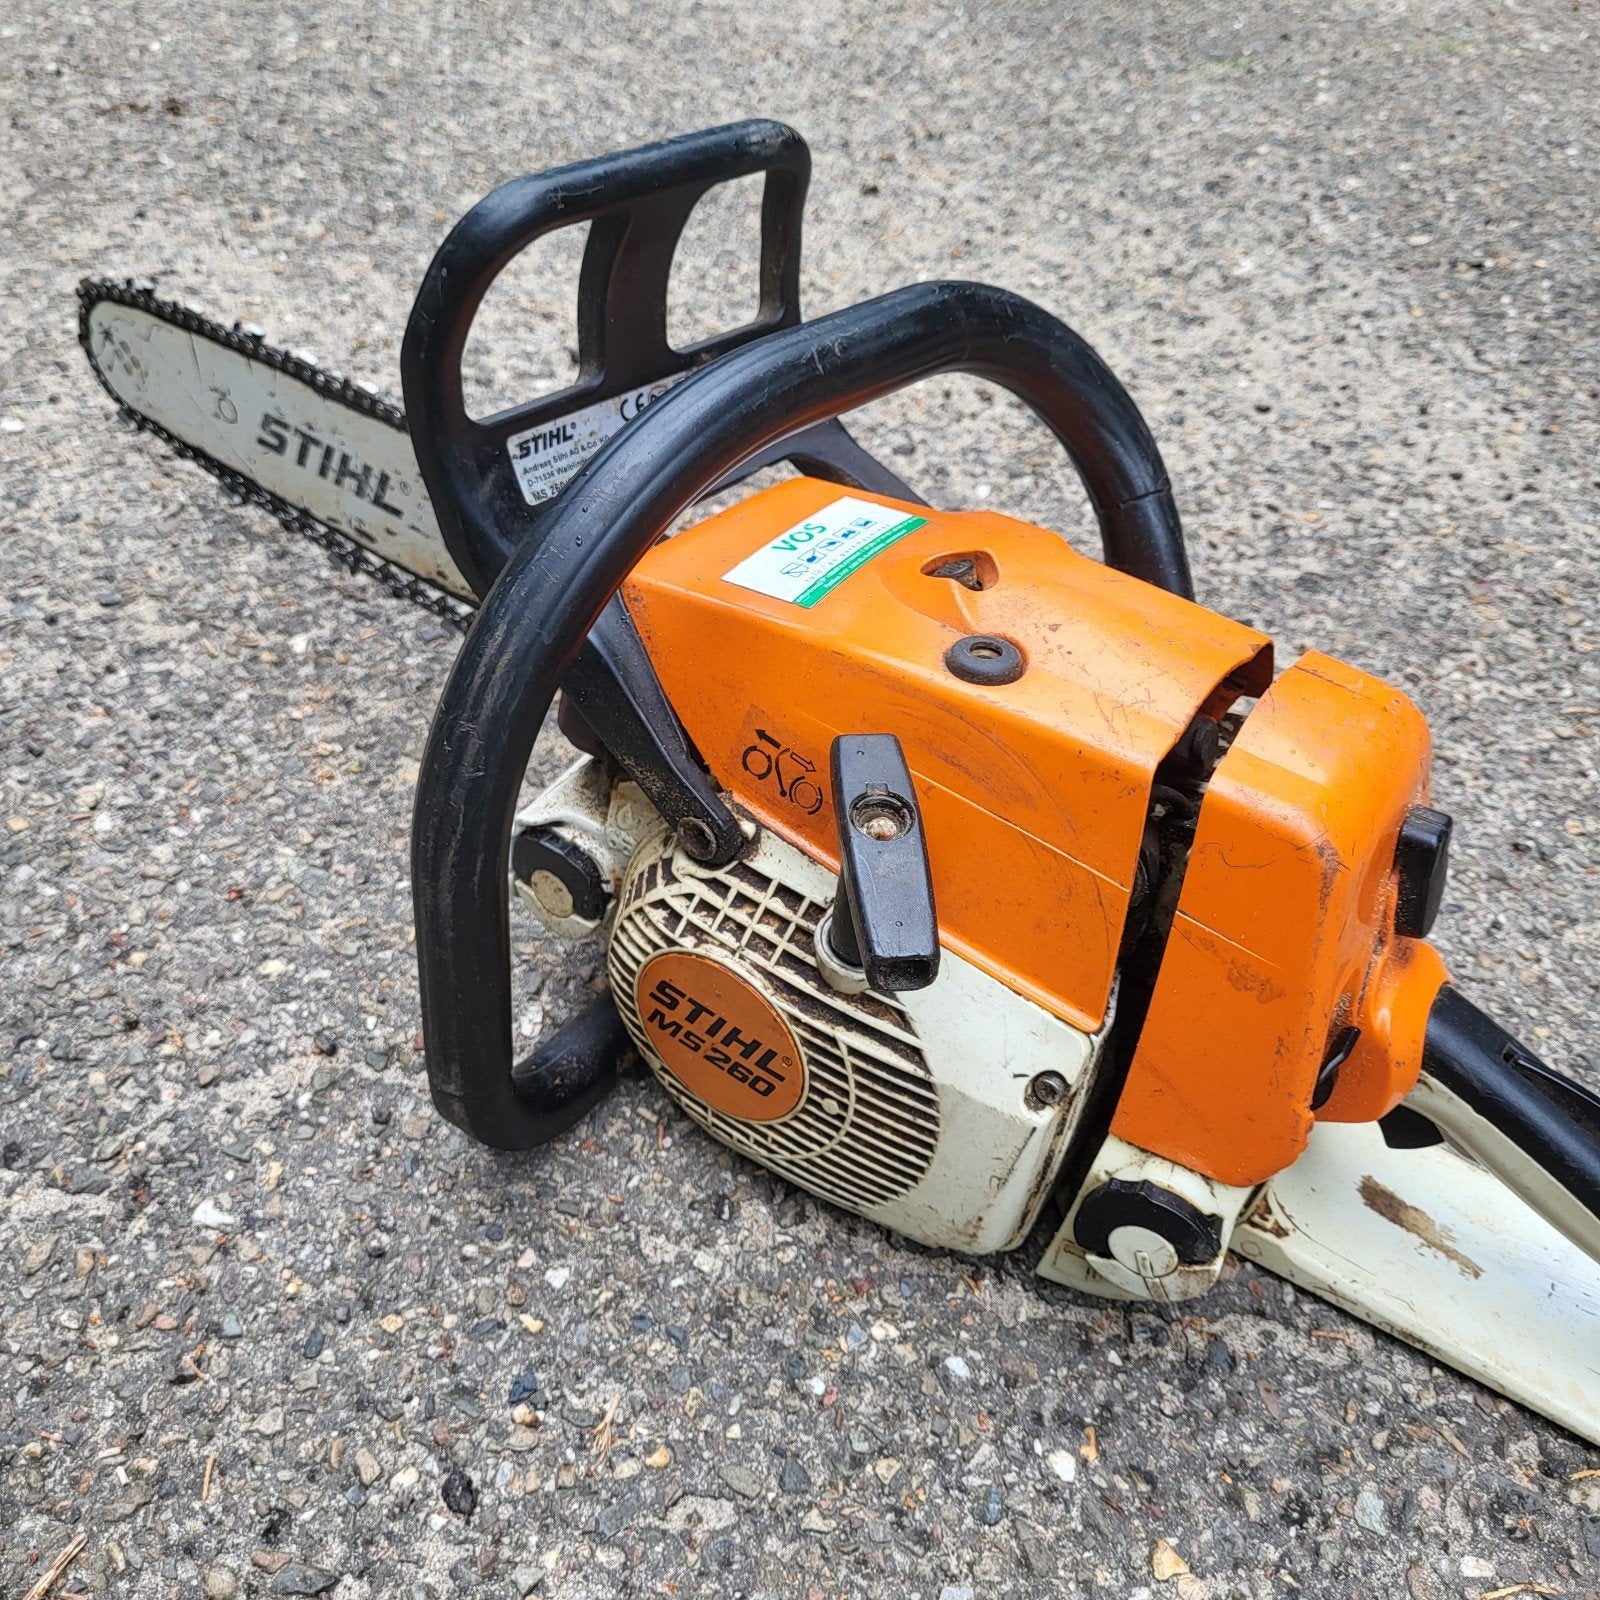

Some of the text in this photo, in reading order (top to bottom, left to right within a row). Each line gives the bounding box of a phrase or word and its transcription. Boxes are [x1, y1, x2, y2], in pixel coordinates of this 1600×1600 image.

[256, 412, 404, 519] STIHL
[517, 423, 574, 460] STIHL
[523, 459, 552, 476] Andreas
[553, 453, 568, 464] Stihl
[771, 523, 827, 552] VOS
[647, 1008, 776, 1097] MS 260
[649, 980, 786, 1082] STIHL
